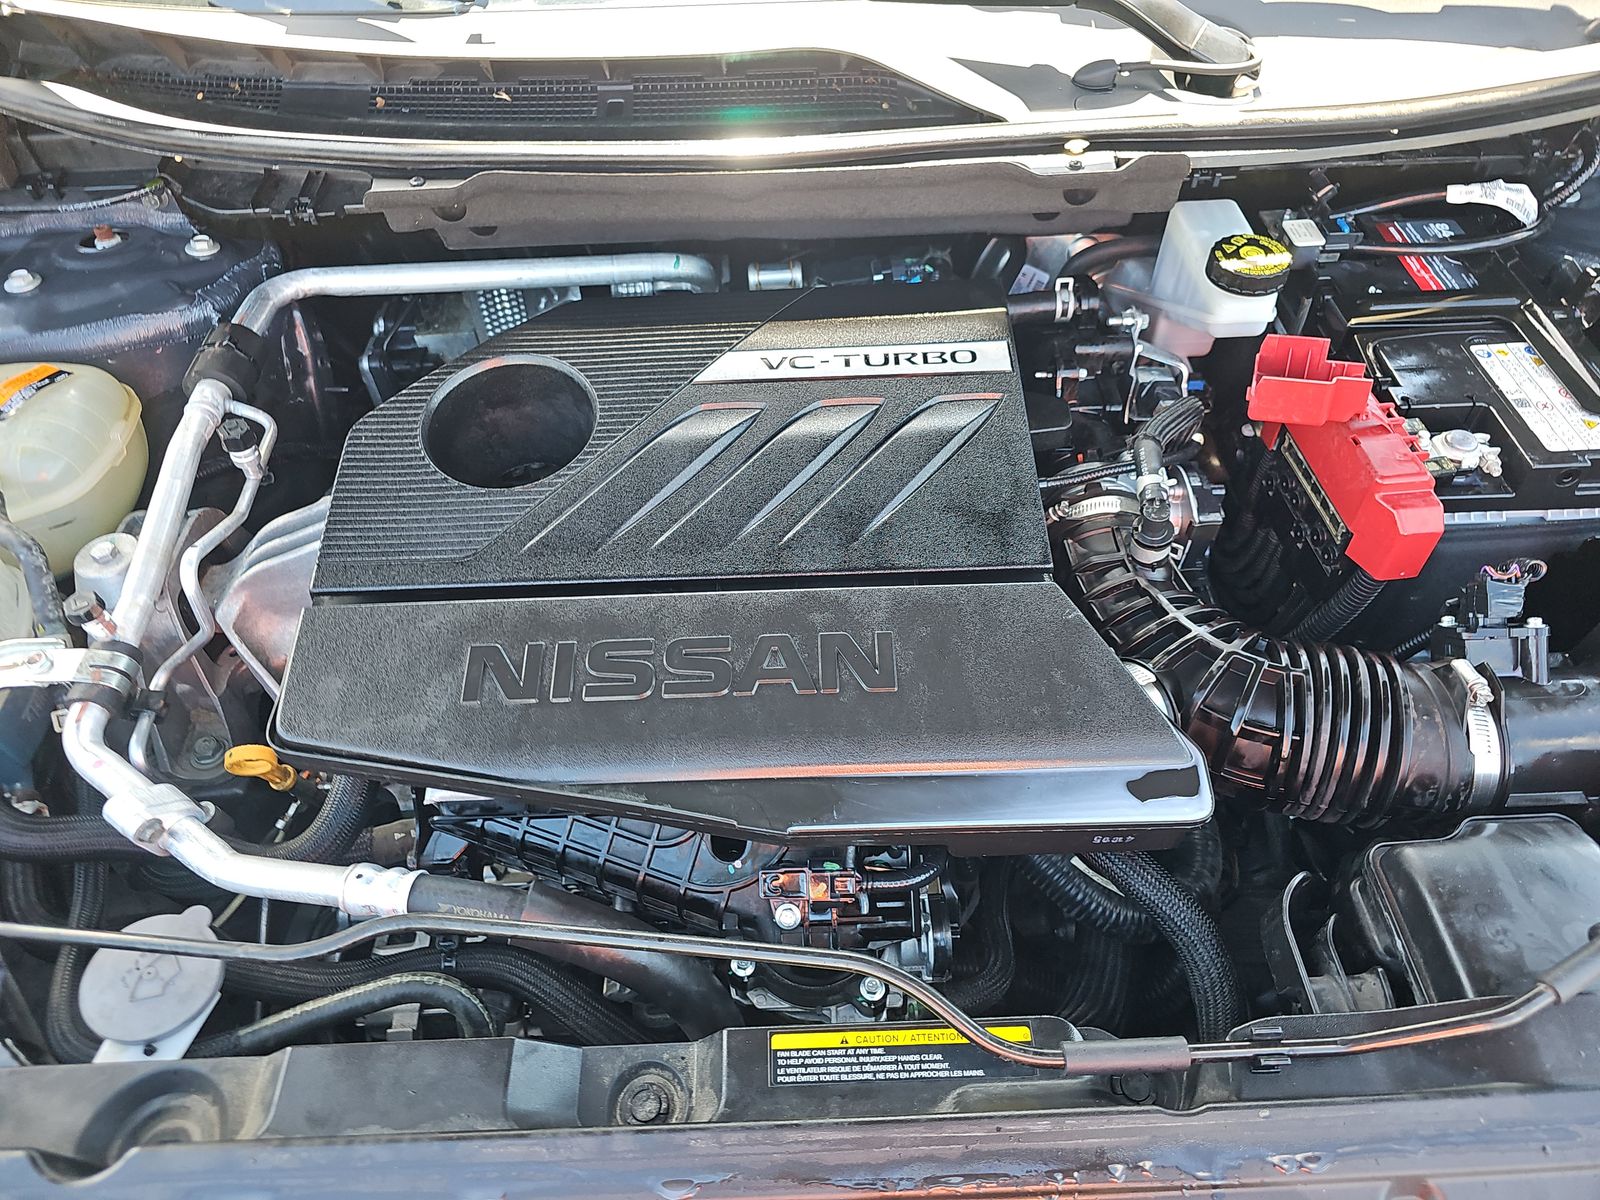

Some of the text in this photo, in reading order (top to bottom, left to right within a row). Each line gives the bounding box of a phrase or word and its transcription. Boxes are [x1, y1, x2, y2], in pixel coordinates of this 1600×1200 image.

[760, 350, 977, 370] VC-TURBO
[460, 630, 898, 704] NISSAN
[856, 1034, 899, 1044] CAUTION
[910, 1033, 964, 1042] ATTENTION
[869, 1047, 886, 1055] TIME.
[824, 1056, 858, 1064] PERSONAL
[921, 1053, 944, 1061] CLEAR.
[777, 1067, 786, 1075] LE
[786, 1066, 827, 1075] VENTILATEUR
[862, 1063, 897, 1072] DÉMARRER
[897, 1062, 903, 1071] À
[903, 1063, 921, 1071] TOUT
[921, 1062, 951, 1070] MOMENT.
[777, 1075, 796, 1083] POUR
[796, 1074, 819, 1082] ÉVITER
[840, 1073, 876, 1081] BLESSURE,
[876, 1072, 886, 1080] NE
[899, 1071, 909, 1079] EN
[909, 1070, 950, 1079] APPROCHER
[963, 1069, 986, 1077] MAINS.
